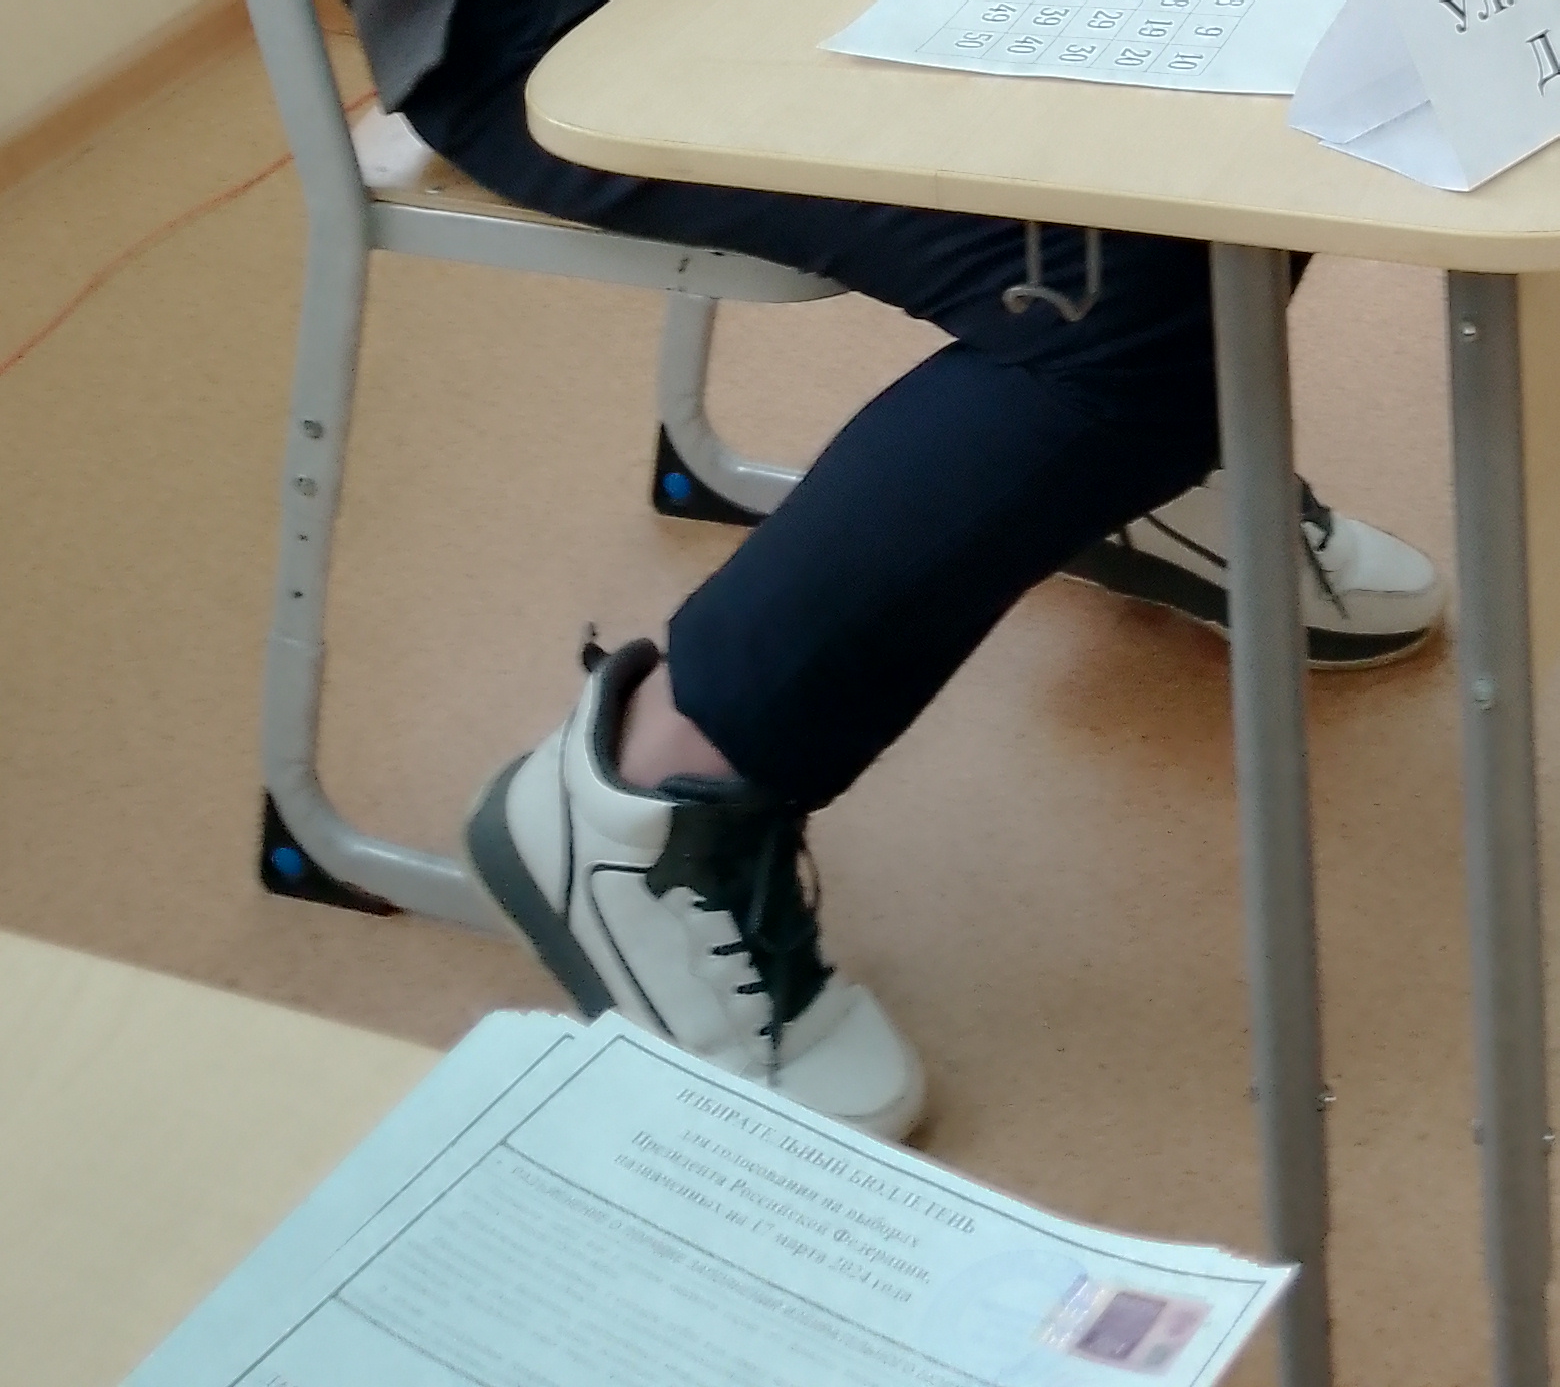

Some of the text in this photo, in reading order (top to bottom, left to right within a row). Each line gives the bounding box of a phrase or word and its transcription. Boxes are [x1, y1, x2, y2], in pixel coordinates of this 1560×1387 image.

[981, 3, 1017, 23] 49
[1032, 7, 1070, 26] 39
[1086, 10, 1124, 29] 29
[1138, 19, 1173, 38] 19
[1194, 26, 1224, 37] 9
[954, 32, 993, 49] 50
[1006, 36, 1044, 54] 40
[1058, 44, 1097, 62] 30
[1114, 48, 1152, 66] 20
[1167, 52, 1204, 70] 10
